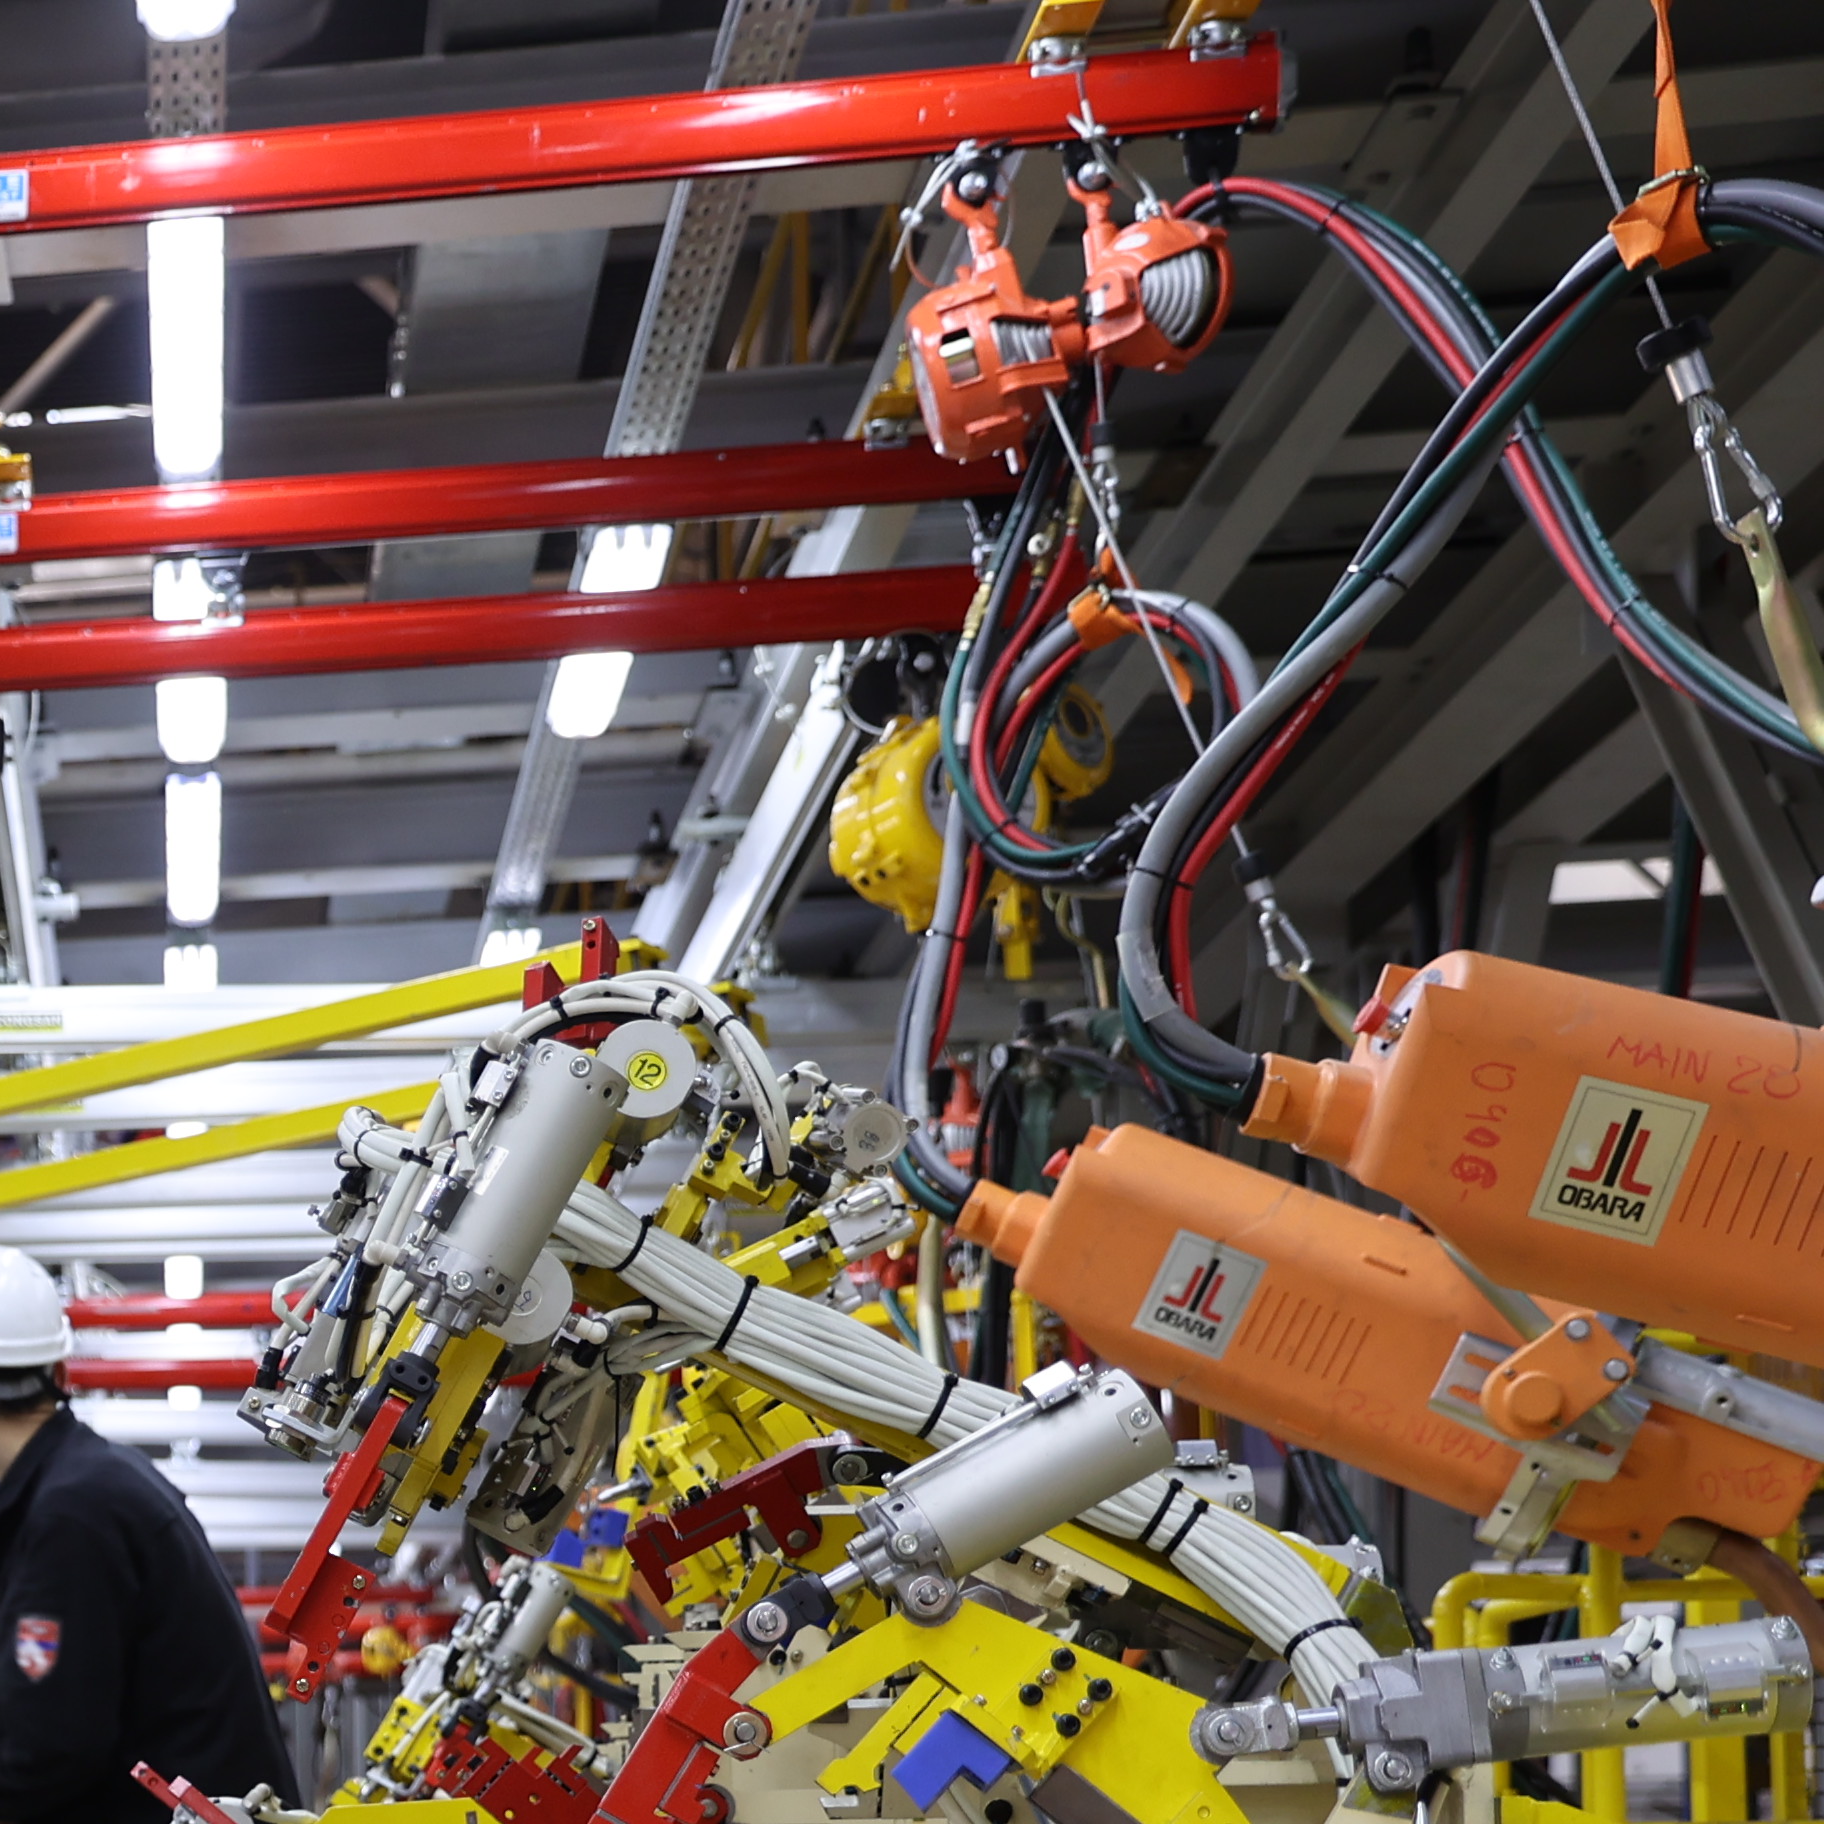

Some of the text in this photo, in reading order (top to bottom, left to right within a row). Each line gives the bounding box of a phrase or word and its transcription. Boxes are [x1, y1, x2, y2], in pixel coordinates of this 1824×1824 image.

[634, 1057, 662, 1087] 12
[1606, 1036, 1712, 1084] MAIN
[1557, 1184, 1646, 1222] OBARA
[1154, 1306, 1218, 1342] OBARA
